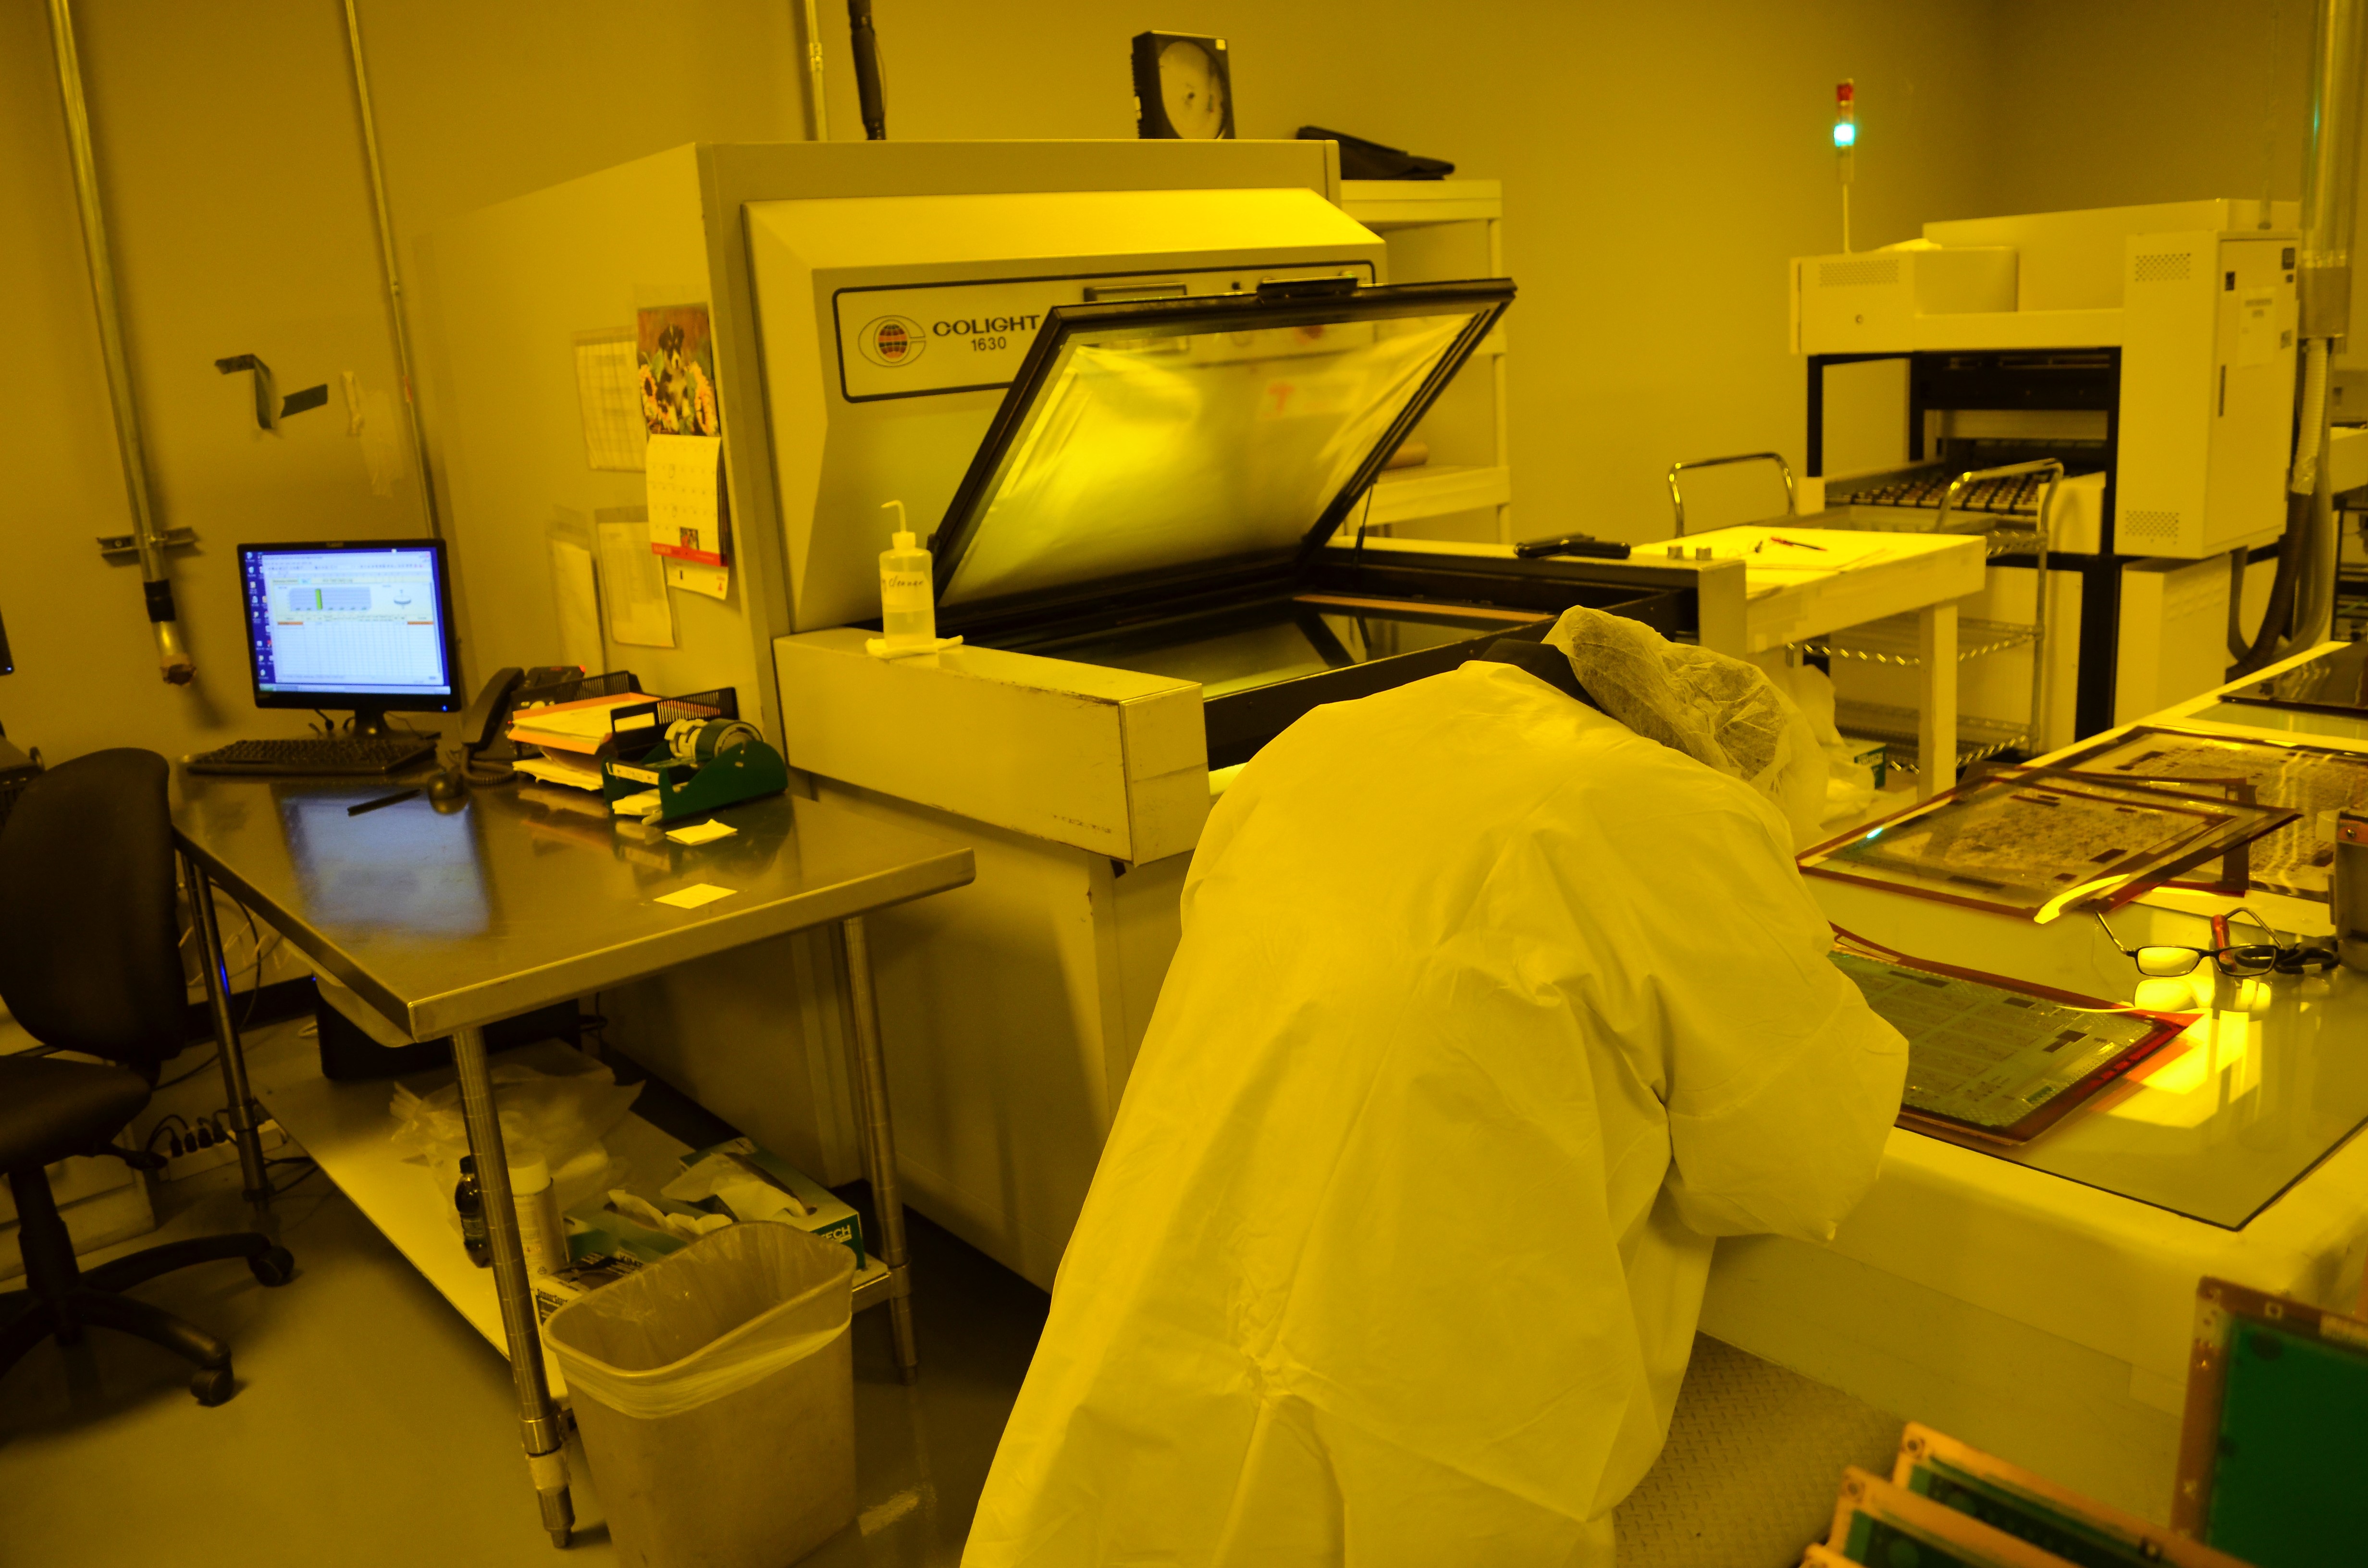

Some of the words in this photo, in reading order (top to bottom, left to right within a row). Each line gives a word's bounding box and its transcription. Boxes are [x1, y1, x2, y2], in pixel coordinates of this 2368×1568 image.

[932, 315, 1040, 336] COLIGHT
[971, 336, 1006, 351] 1630
[821, 1224, 851, 1240] ECH
